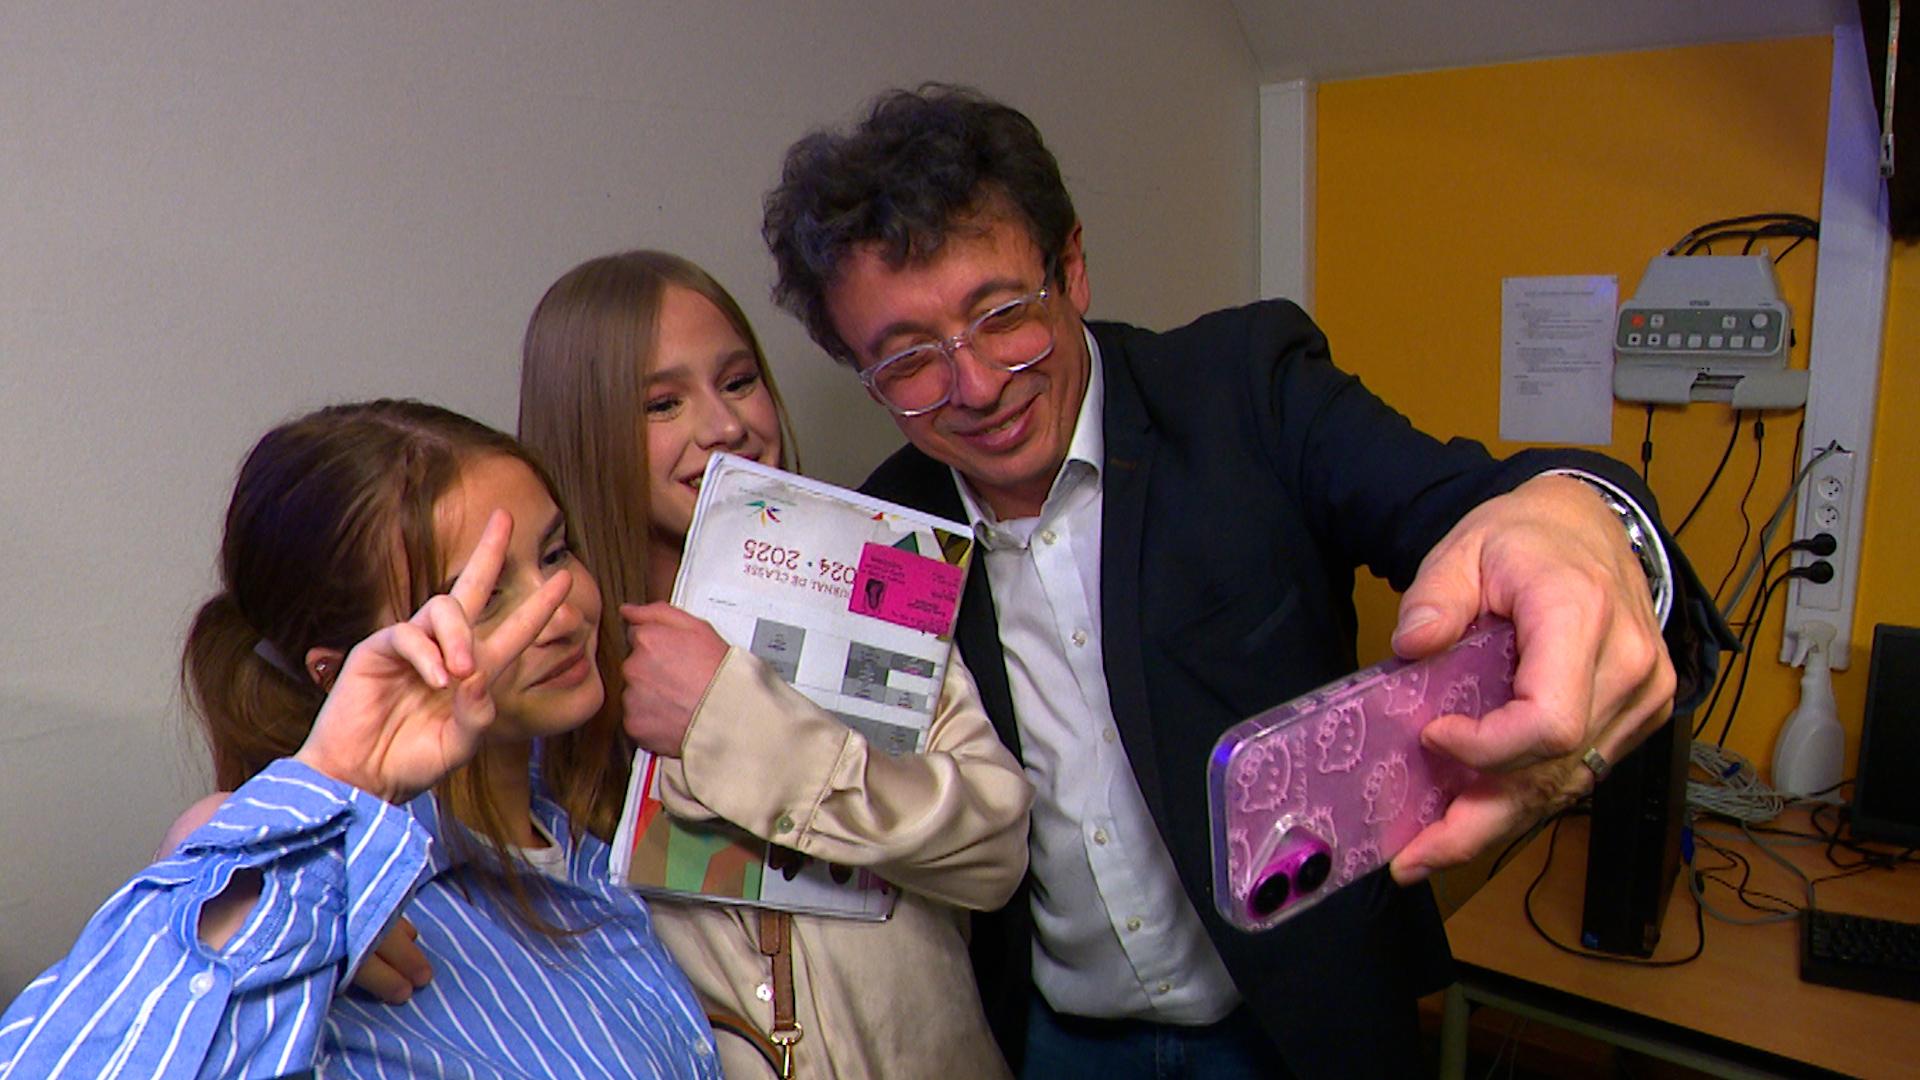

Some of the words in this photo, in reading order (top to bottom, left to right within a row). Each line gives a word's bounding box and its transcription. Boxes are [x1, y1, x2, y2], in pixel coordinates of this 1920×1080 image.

[744, 539, 801, 570] 2025
[743, 564, 789, 581] CLASSE
[820, 558, 856, 584] 024
[790, 575, 808, 587] DE
[812, 581, 850, 598] URNAL
